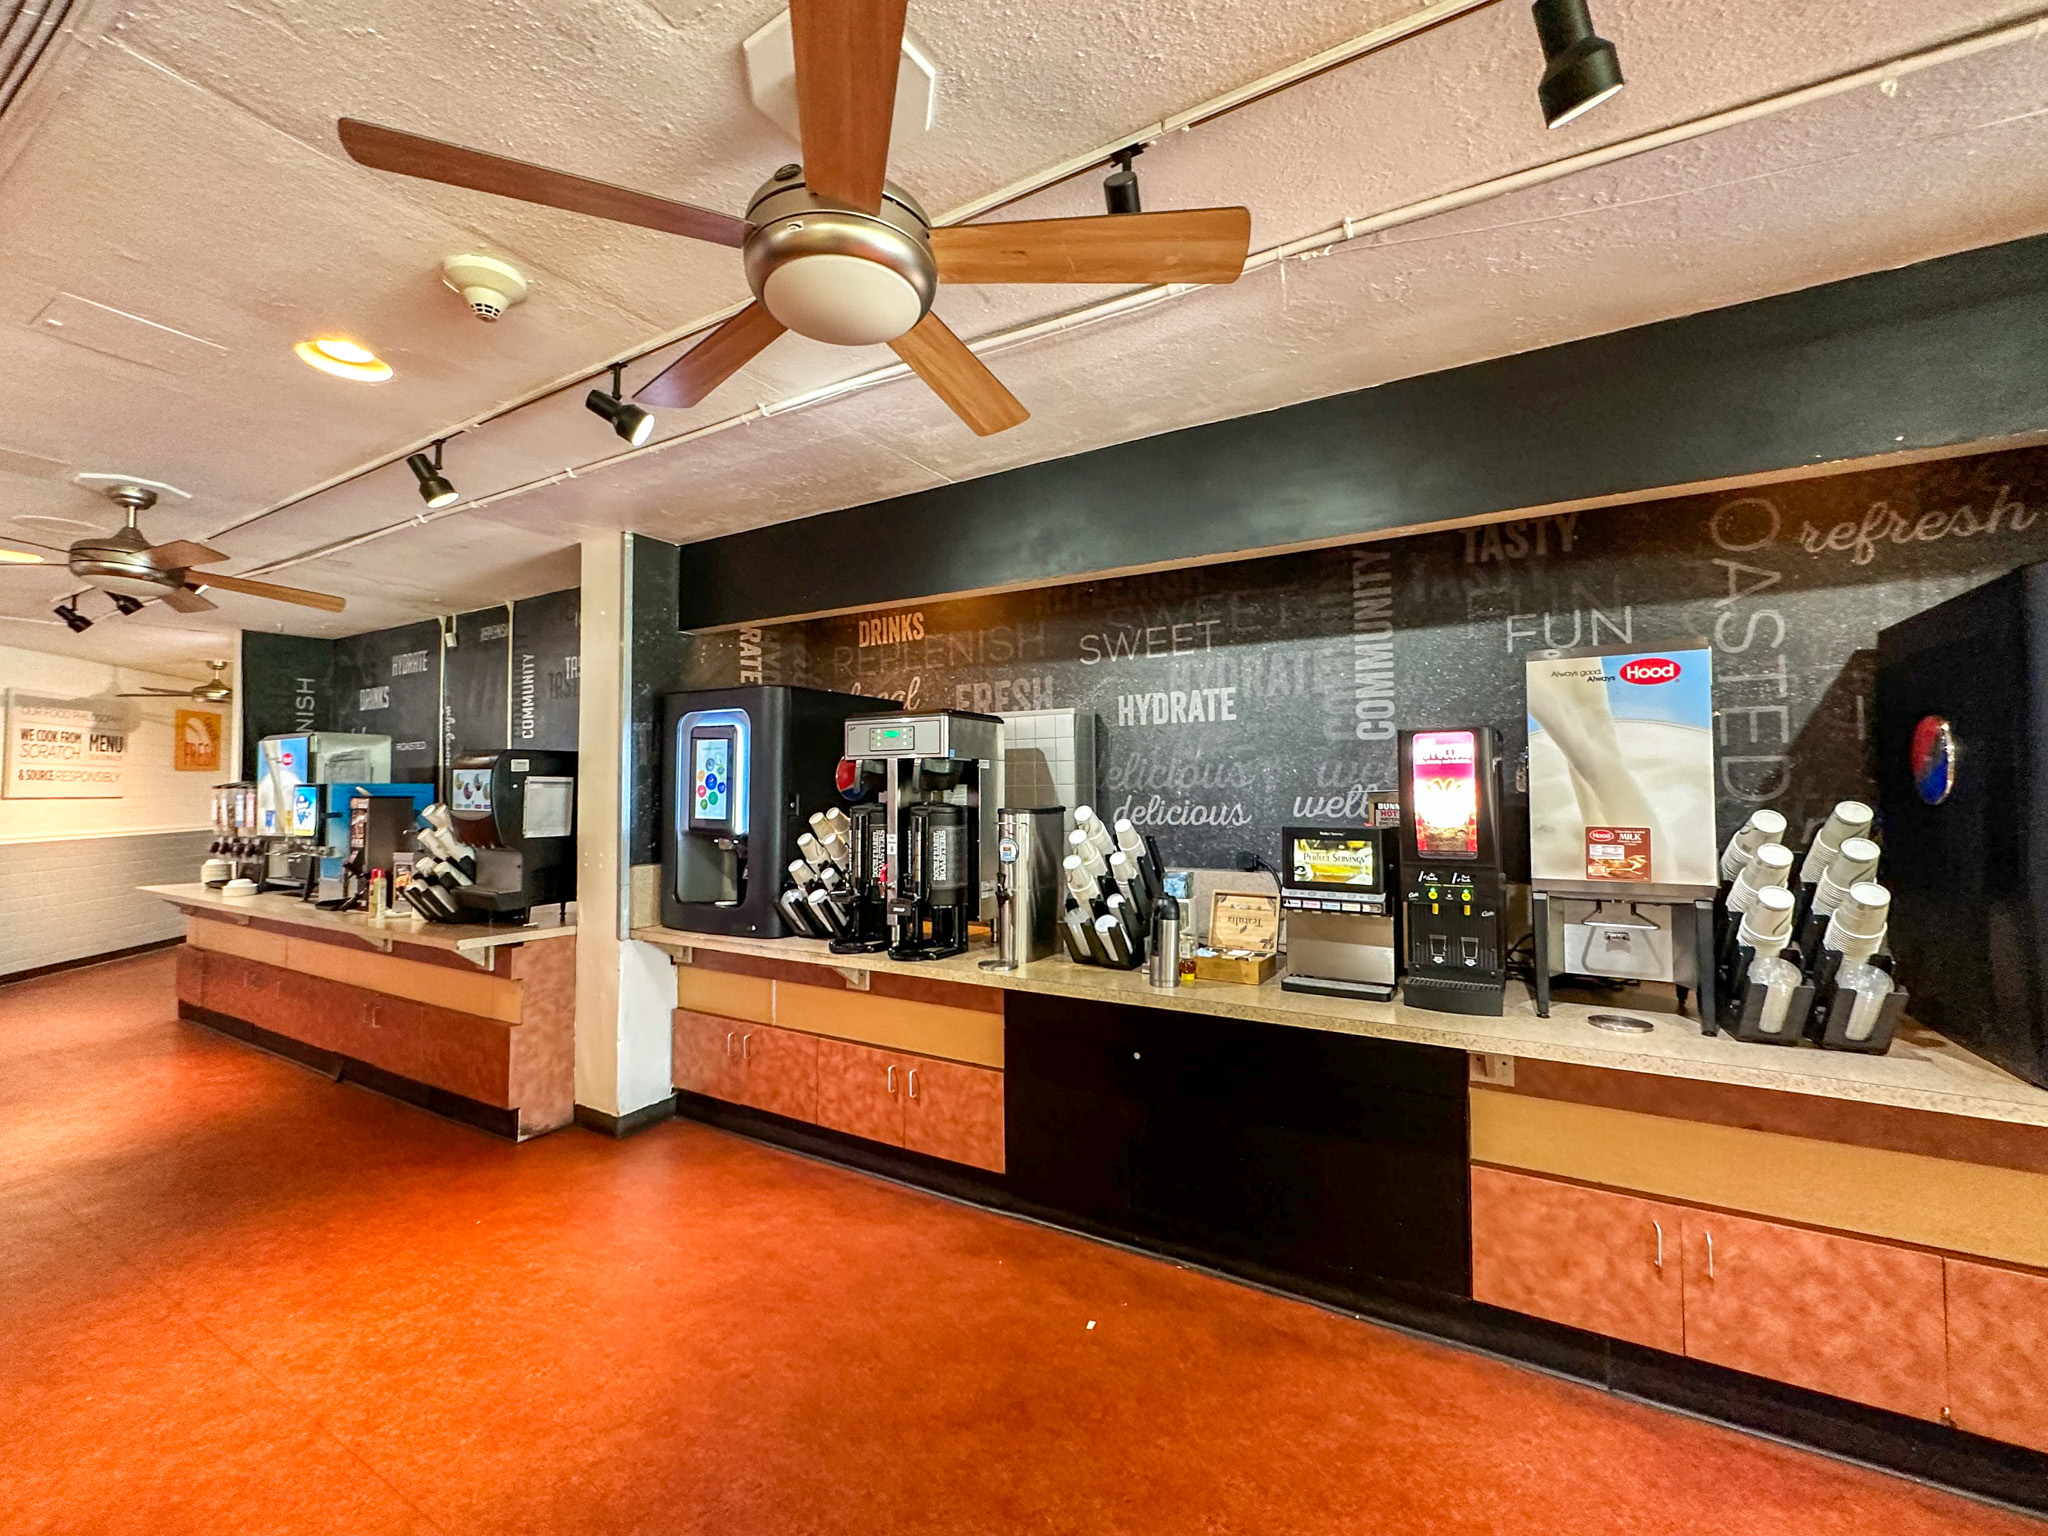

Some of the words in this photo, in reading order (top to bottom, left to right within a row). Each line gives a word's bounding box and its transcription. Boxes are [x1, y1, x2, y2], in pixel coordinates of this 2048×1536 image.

[1460, 513, 1577, 563] TASTY
[1801, 486, 2040, 565] refresh
[858, 612, 925, 648] DRINKS
[1079, 619, 1221, 665] SWEET
[1506, 605, 1633, 652] FUN
[1353, 550, 1396, 741] COMMUNITY
[1551, 669, 1579, 679] Always
[1586, 675, 1617, 683] Always
[1626, 663, 1675, 680] Hood
[521, 653, 535, 739] COMMUNITY
[956, 675, 1053, 713] FRESH
[1118, 687, 1237, 726] HYDRATE
[19, 743, 81, 760] SCRATCH
[21, 728, 35, 742] WE
[36, 730, 59, 743] COOK
[60, 731, 82, 744] FROM
[88, 734, 124, 753] MENU
[25, 770, 54, 781] SOURCE
[1113, 794, 1253, 827] delicious
[1380, 810, 1398, 818] HOT
[1619, 833, 1642, 841] MILK
[1227, 915, 1263, 928] Teatulia
